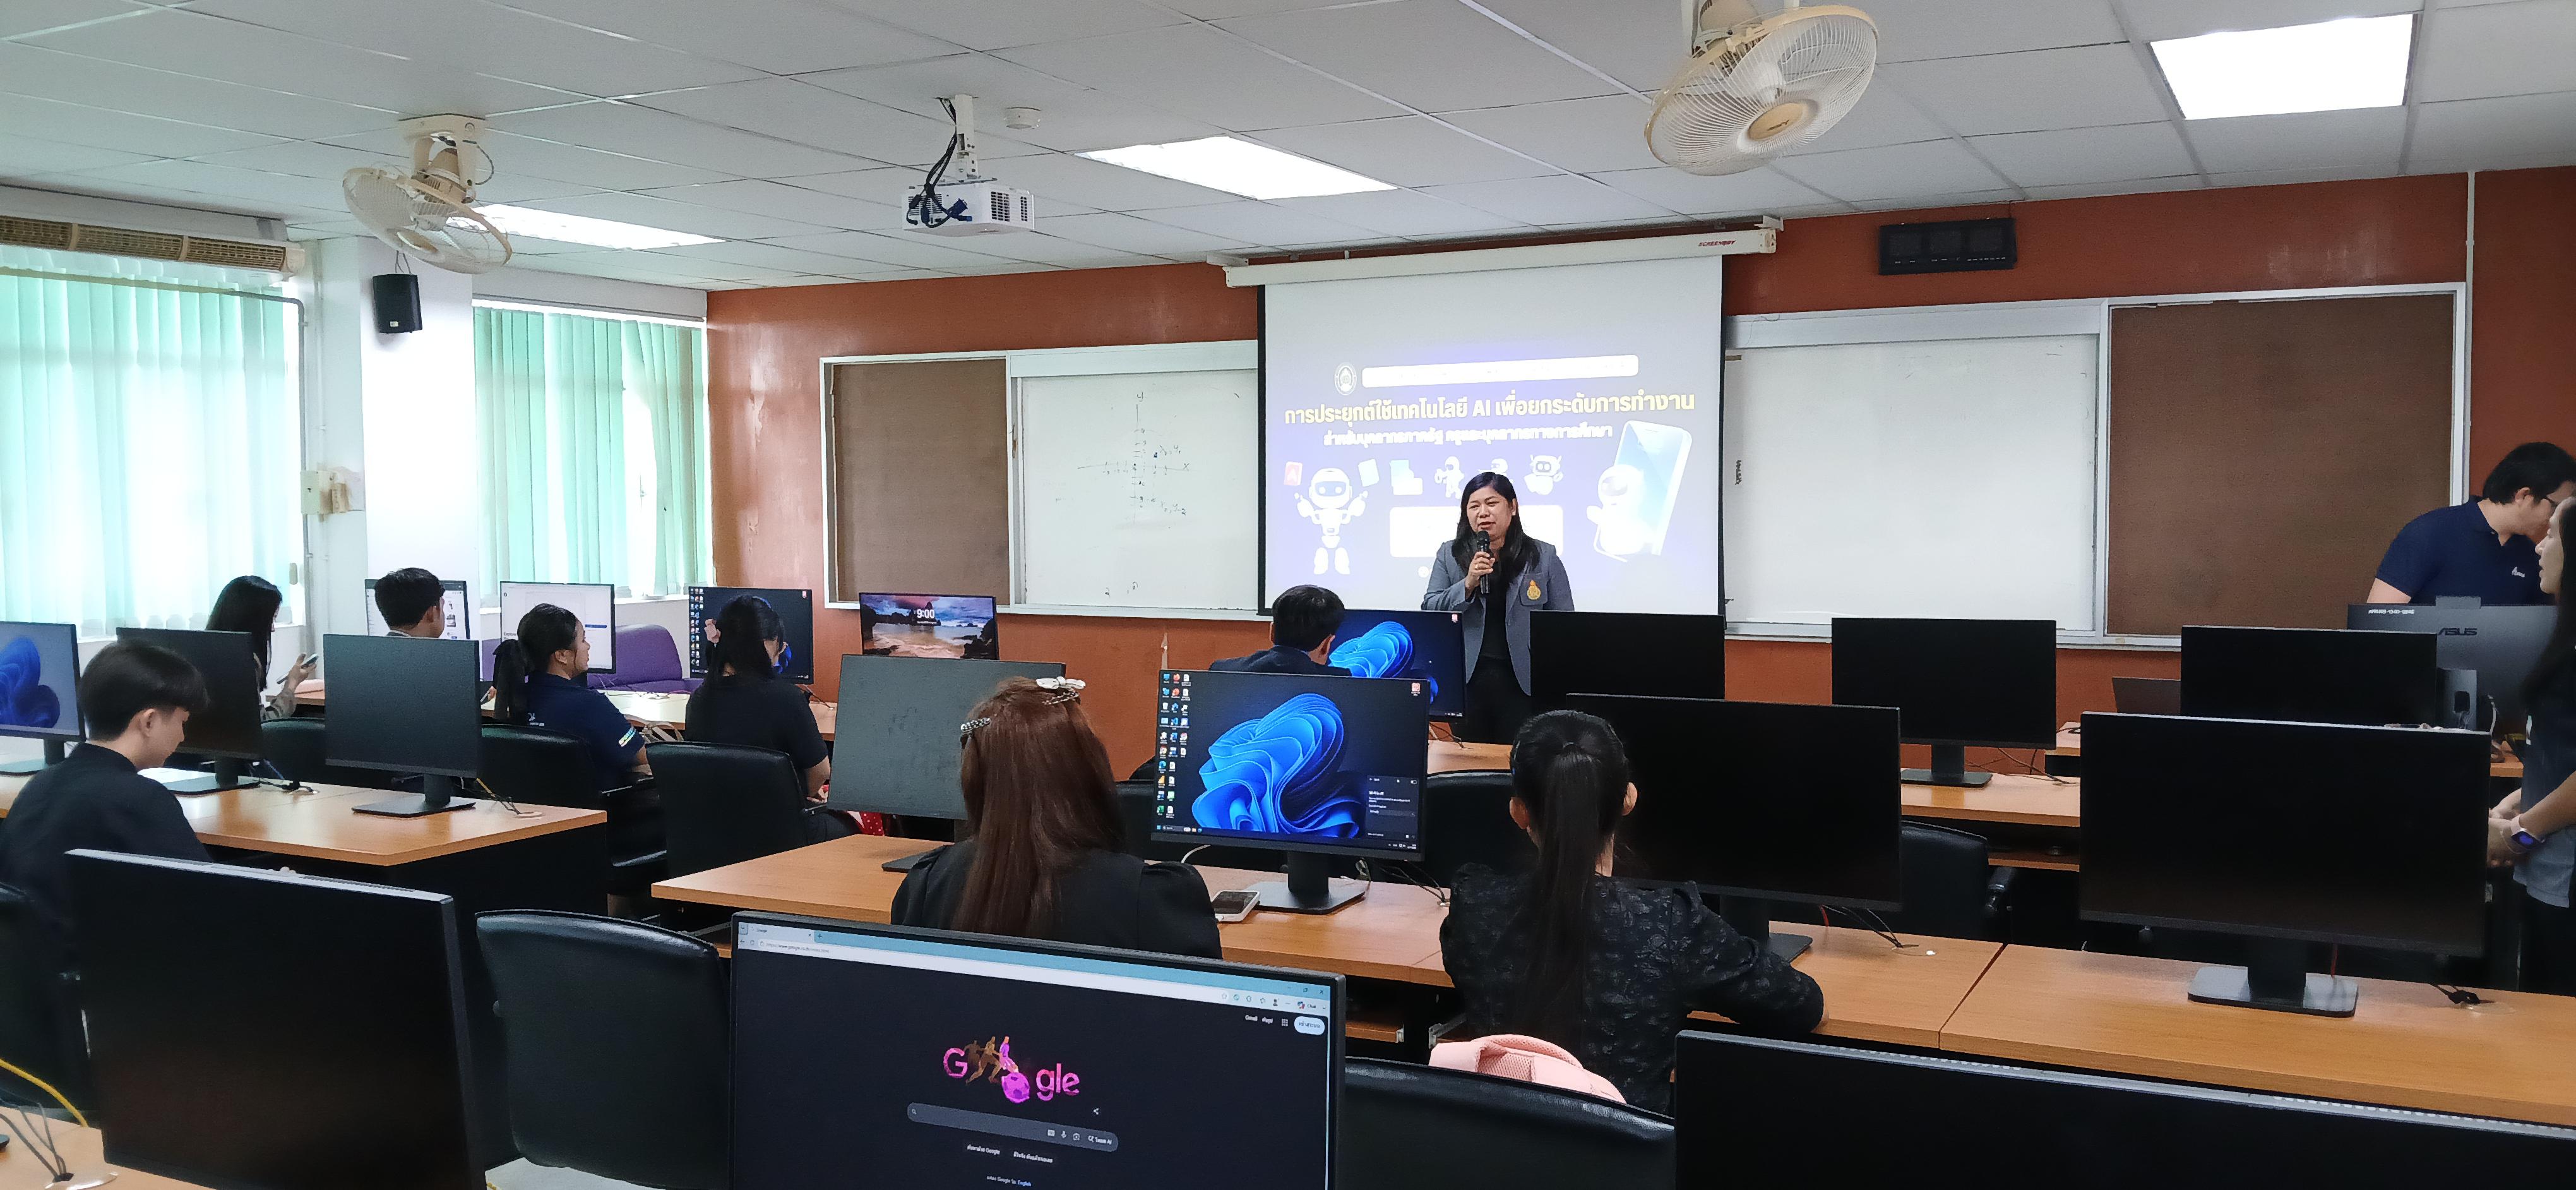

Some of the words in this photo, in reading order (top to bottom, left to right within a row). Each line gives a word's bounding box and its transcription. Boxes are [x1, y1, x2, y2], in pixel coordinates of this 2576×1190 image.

[1284, 396, 1468, 428] การประยุกต์ใช้เทคโนโลยี
[1472, 399, 1491, 417] AI
[1495, 388, 1695, 416] เพื่อยกระดับการทำงาน
[917, 608, 935, 619] 9:00
[2438, 628, 2478, 636] ASUS
[943, 1036, 1080, 1103] Ggle
